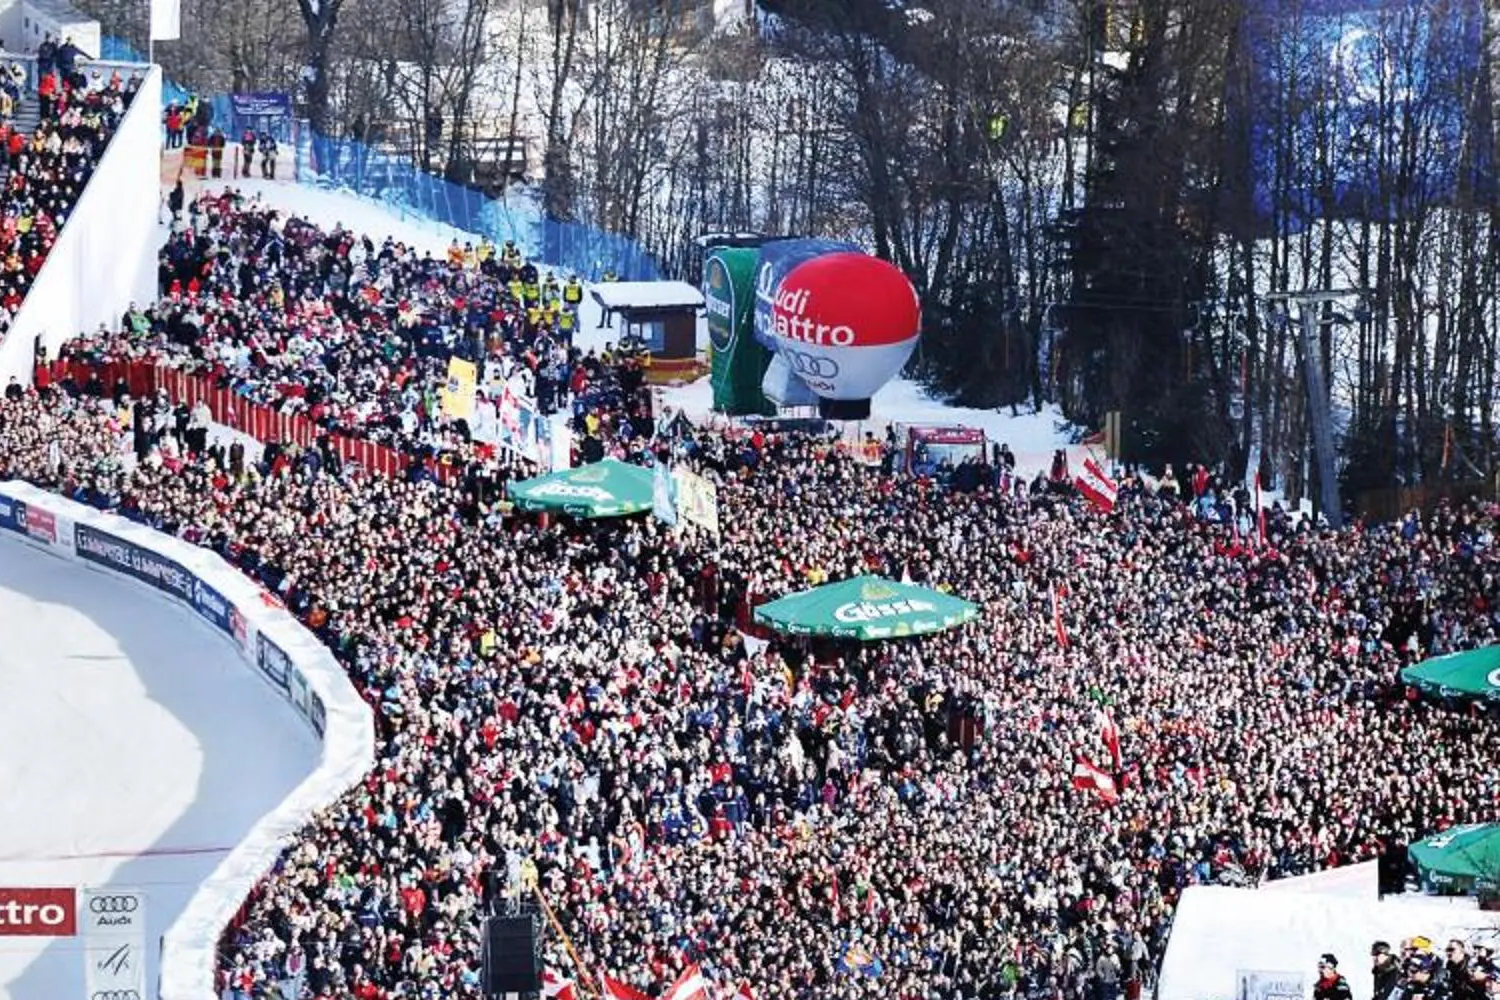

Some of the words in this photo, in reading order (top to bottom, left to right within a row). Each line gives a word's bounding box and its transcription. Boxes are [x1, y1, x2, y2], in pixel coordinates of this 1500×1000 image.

[774, 288, 811, 315] udi
[772, 313, 855, 346] attro
[97, 915, 132, 926] Audi
